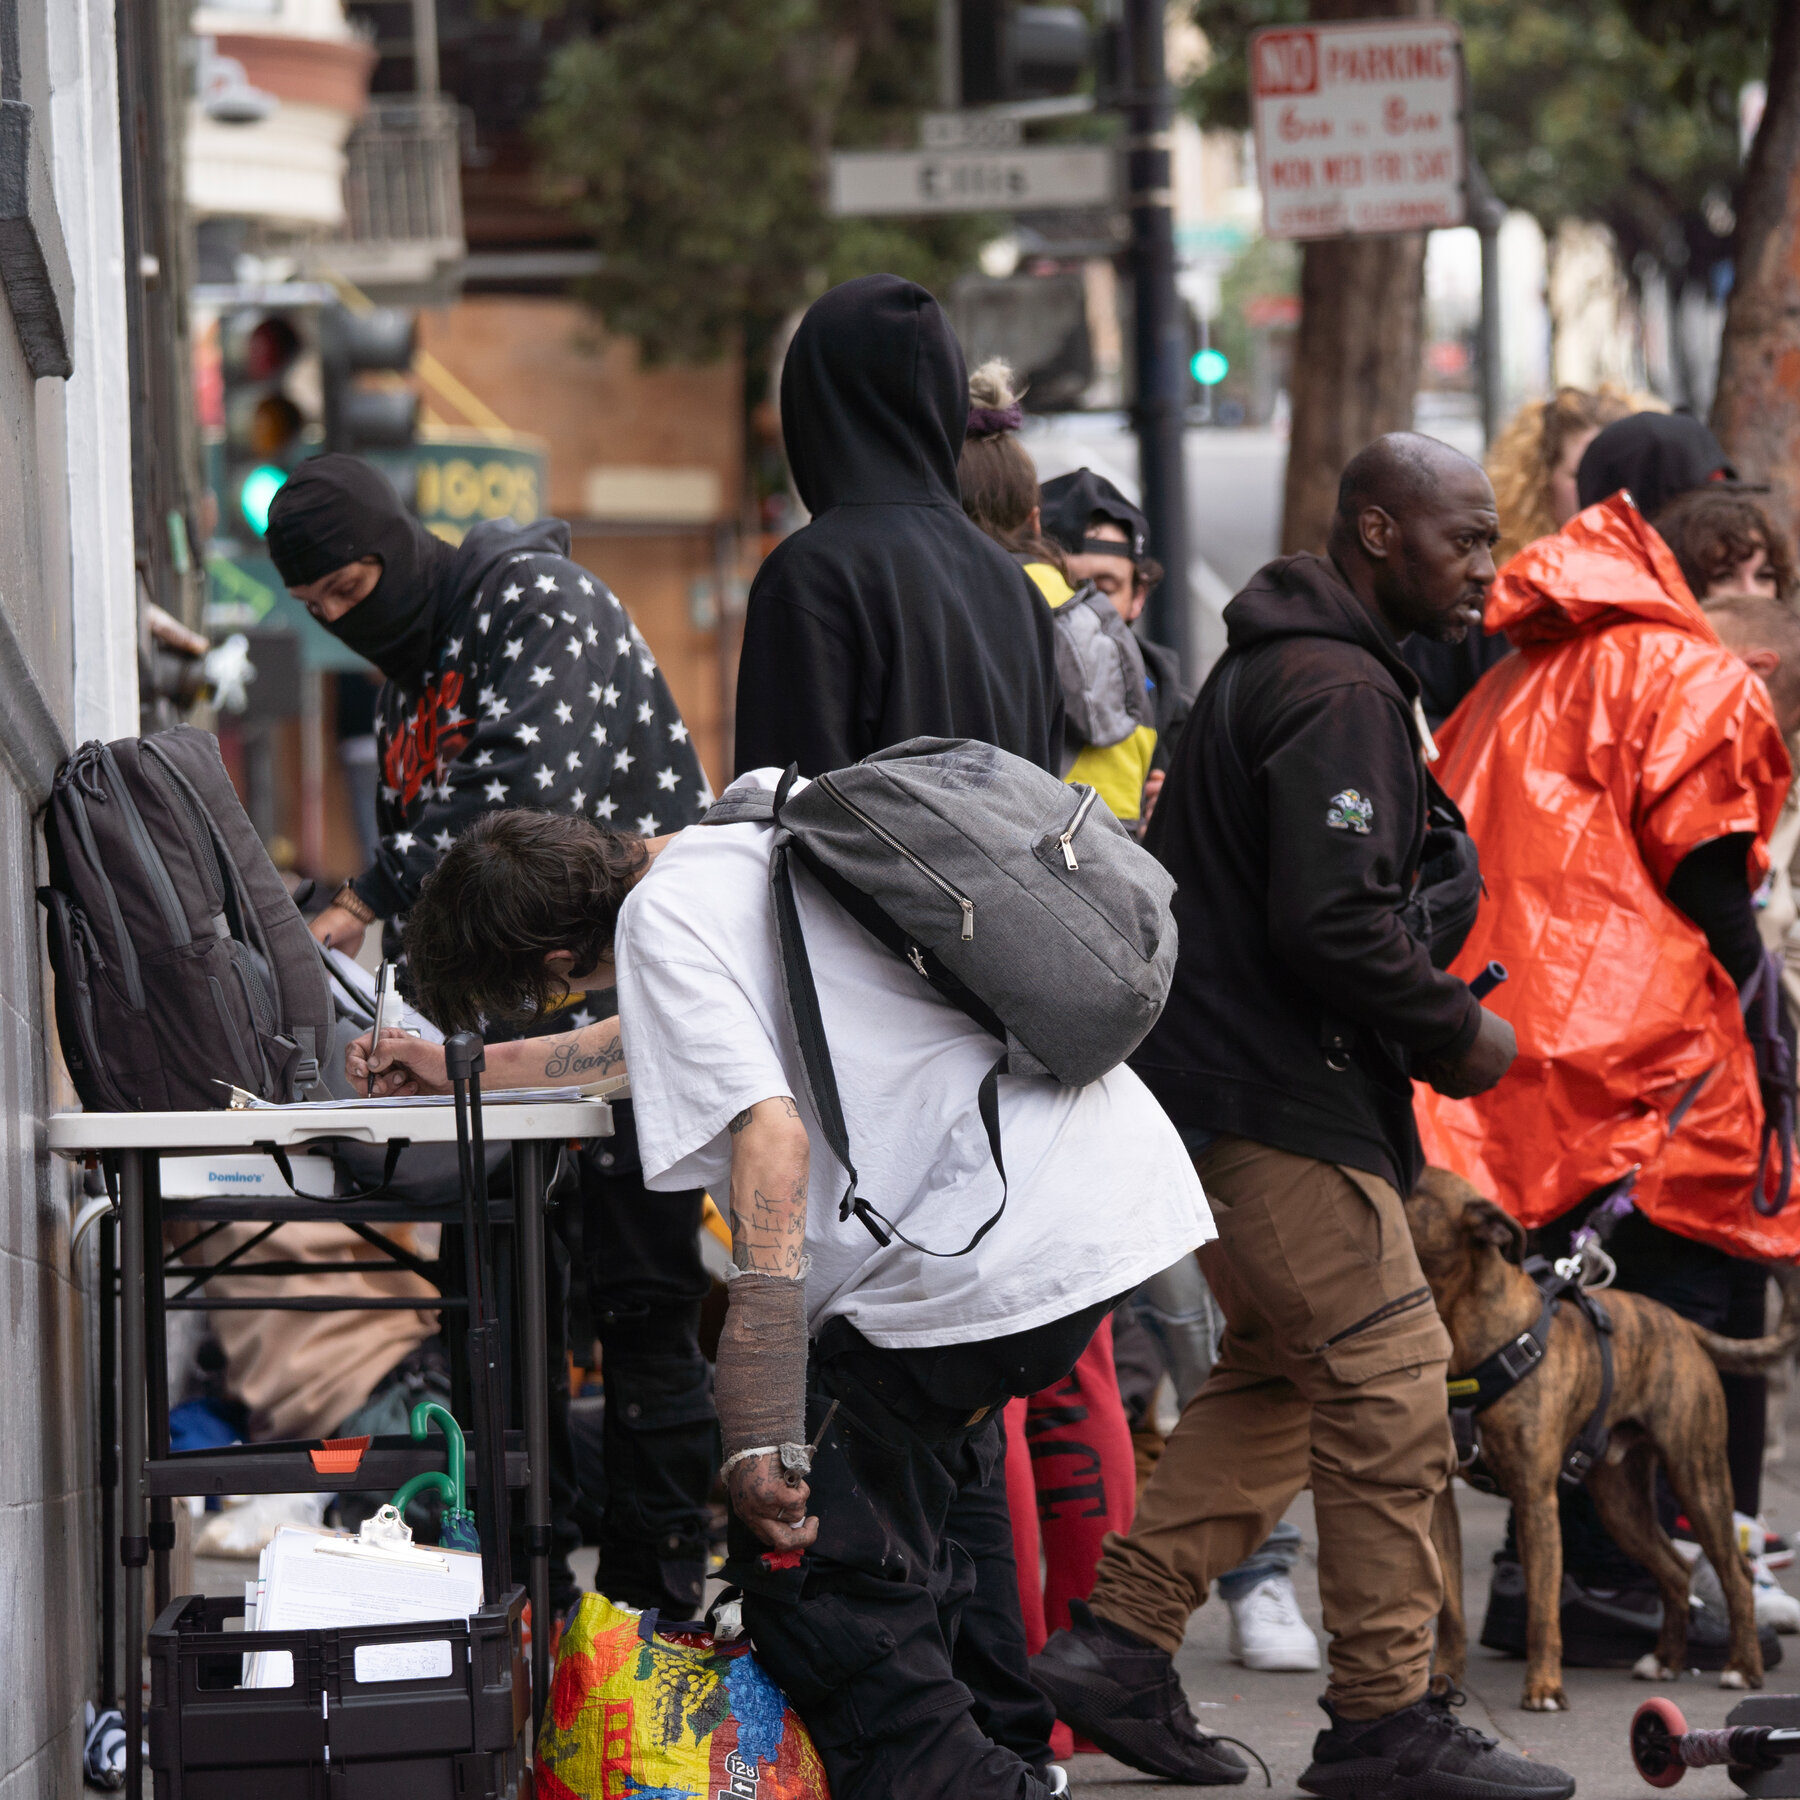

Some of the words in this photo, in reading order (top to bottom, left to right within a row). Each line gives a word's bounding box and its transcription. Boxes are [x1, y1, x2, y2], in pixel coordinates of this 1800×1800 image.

[1259, 38, 1313, 90] NO
[1326, 40, 1450, 84] PARKING
[919, 161, 1028, 200] Ellis
[1271, 157, 1313, 189] MON
[1322, 153, 1364, 187] WED
[1371, 150, 1403, 182] FRI
[1413, 148, 1450, 182] SAT
[208, 1171, 263, 1183] Domino's
[731, 1759, 756, 1778] 128
